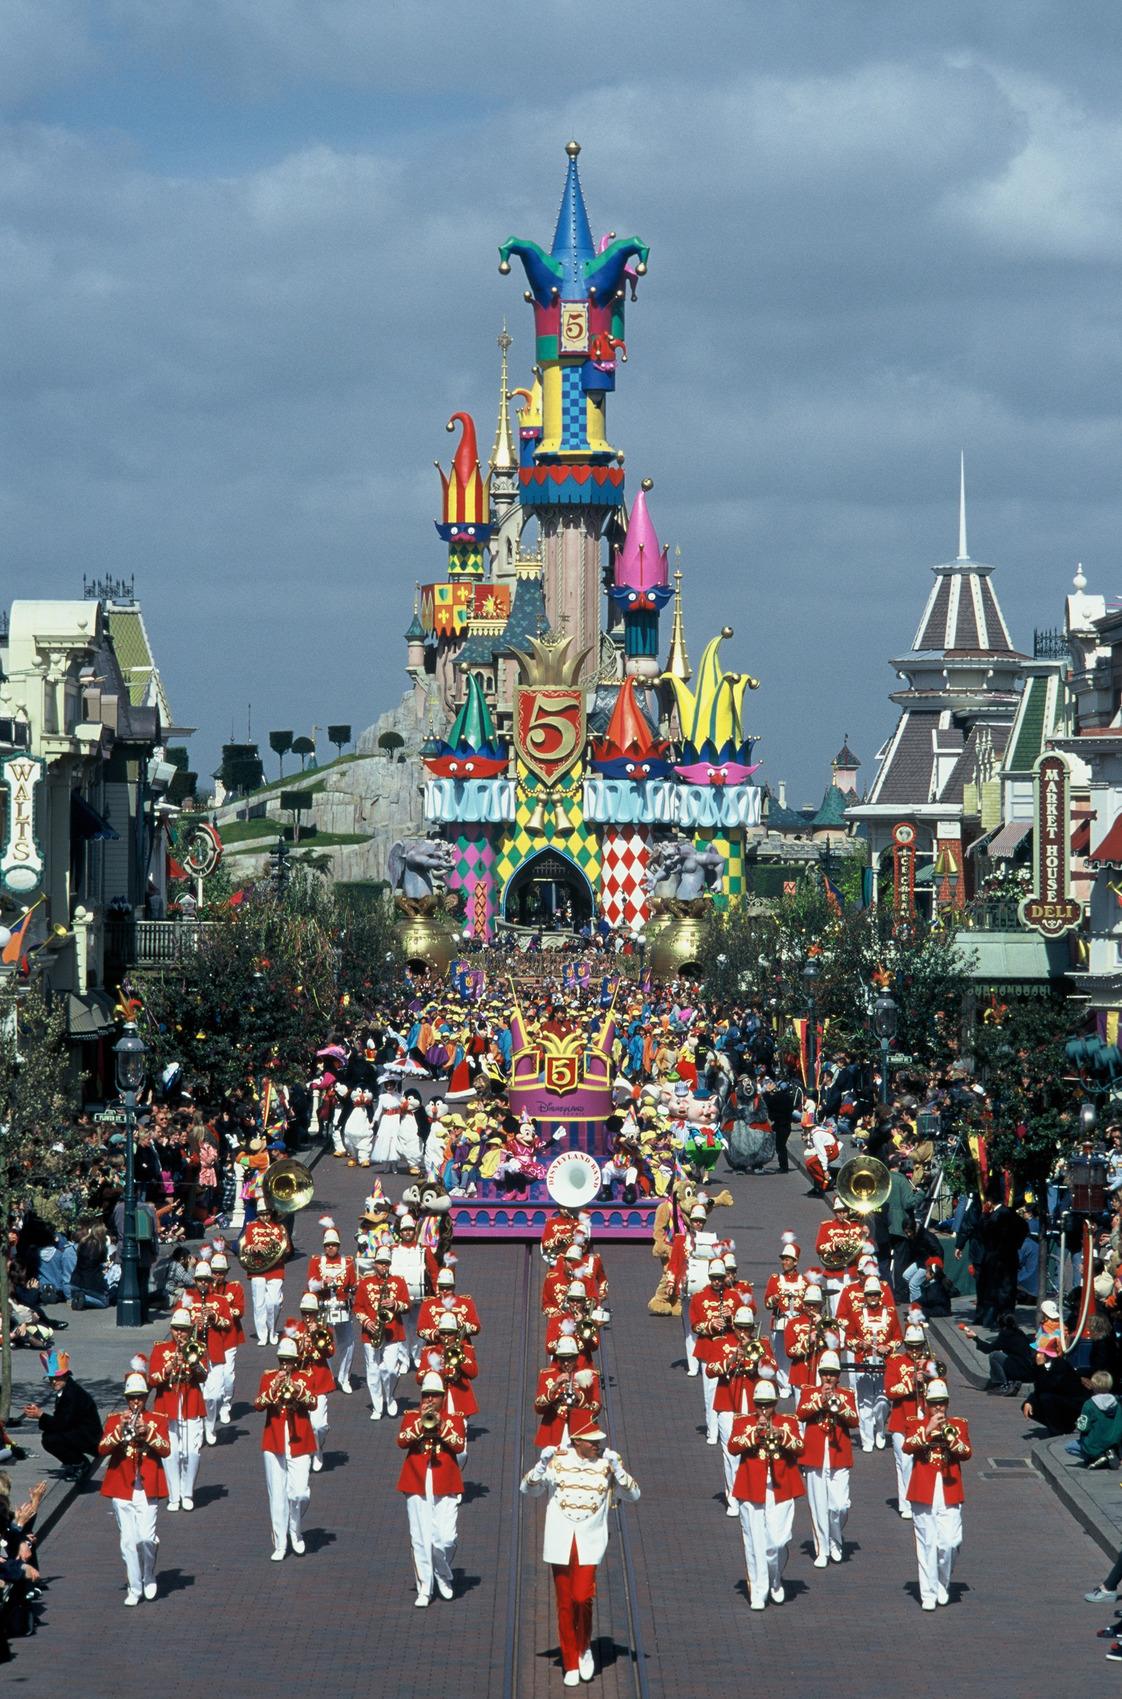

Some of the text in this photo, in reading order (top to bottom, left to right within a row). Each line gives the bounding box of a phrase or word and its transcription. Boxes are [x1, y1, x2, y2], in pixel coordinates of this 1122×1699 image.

[565, 313, 584, 339] 5
[526, 692, 580, 760] 5
[8, 763, 35, 862] WALTS
[1044, 769, 1060, 903] MARKET HOUSE
[900, 848, 909, 874] ICE
[1031, 905, 1072, 918] DELI
[551, 1059, 571, 1085] 5
[548, 1153, 599, 1189] DISNEYLAND BAND
